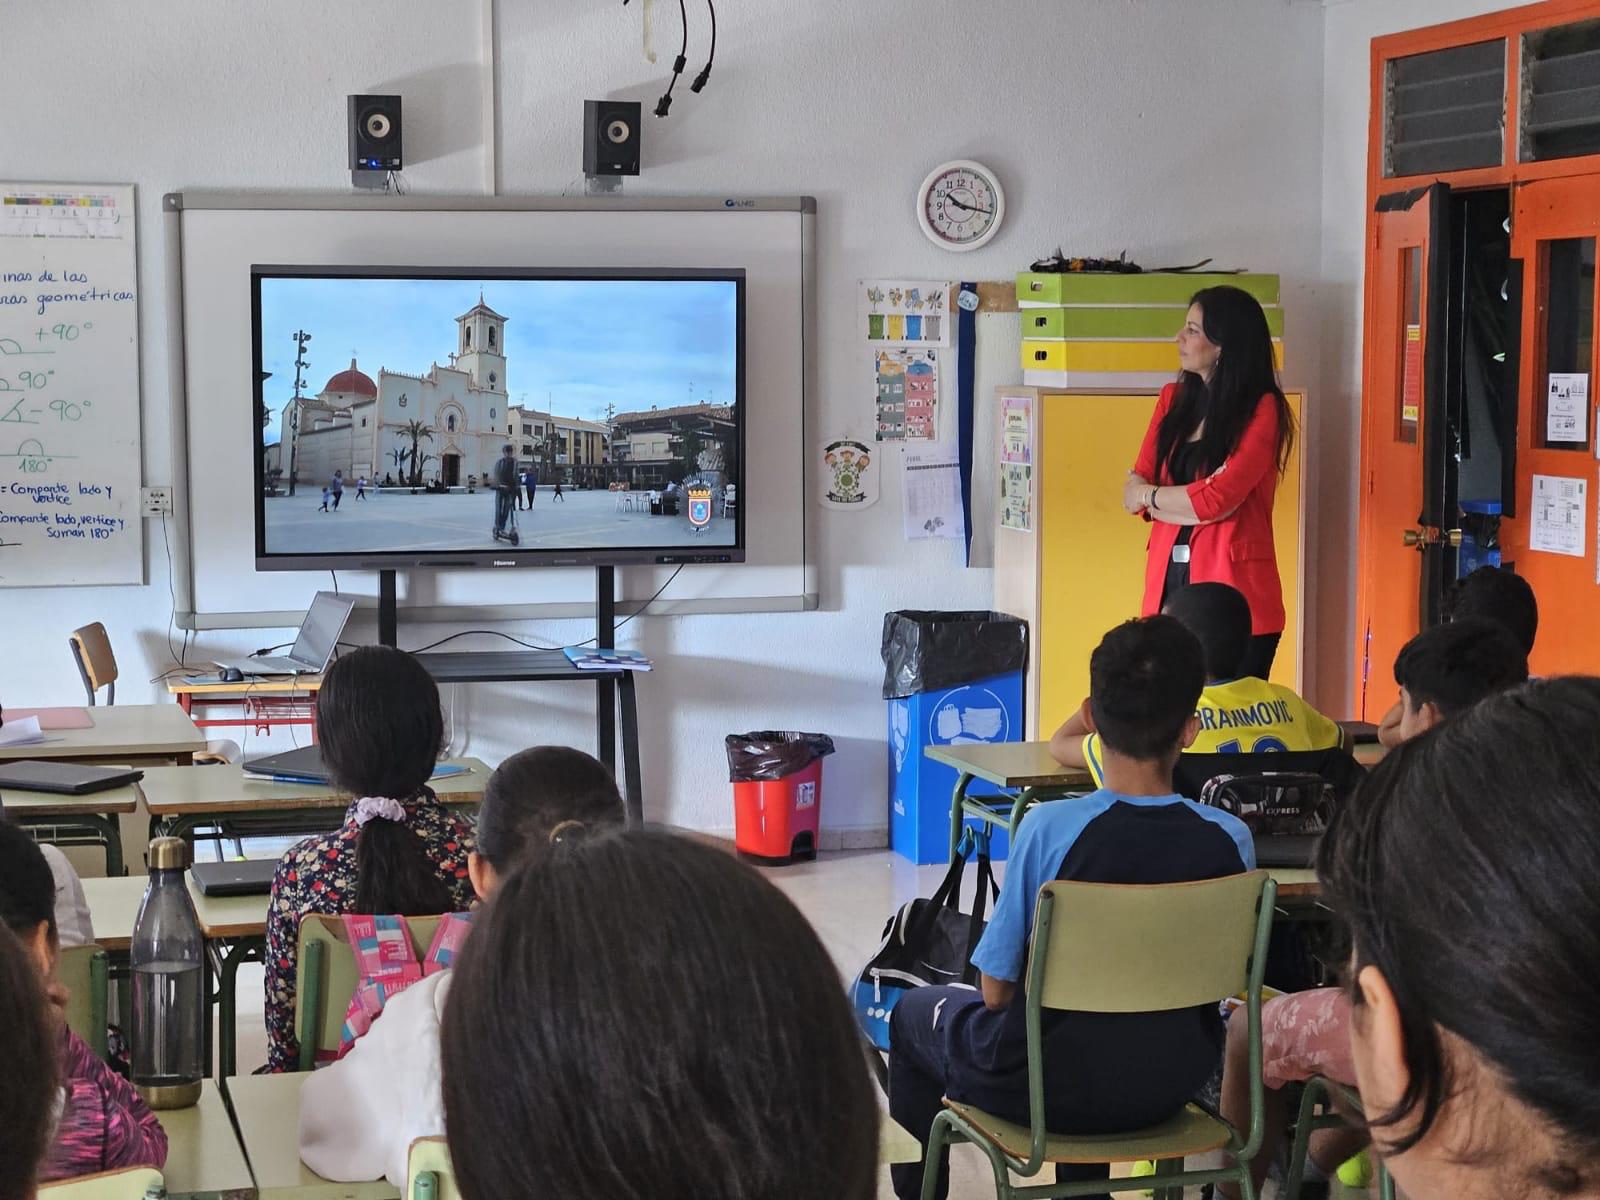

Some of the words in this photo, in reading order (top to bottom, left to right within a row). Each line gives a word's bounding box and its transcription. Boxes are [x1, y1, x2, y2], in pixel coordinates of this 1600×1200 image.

[946, 181, 953, 189] 11
[957, 179, 966, 187] 12
[970, 180, 974, 189] 1
[936, 190, 946, 198] 10
[977, 190, 984, 198] 2
[936, 202, 942, 210] 9
[938, 212, 944, 221] 8
[946, 222, 952, 230] 7
[957, 223, 963, 232] 6
[38, 270, 58, 282] de
[63, 270, 88, 283] las
[10, 482, 70, 496] Comparte
[79, 482, 101, 495] lado
[46, 527, 86, 539] Suman
[90, 527, 115, 539] 180°
[1266, 807, 1300, 816] EXPRESS
